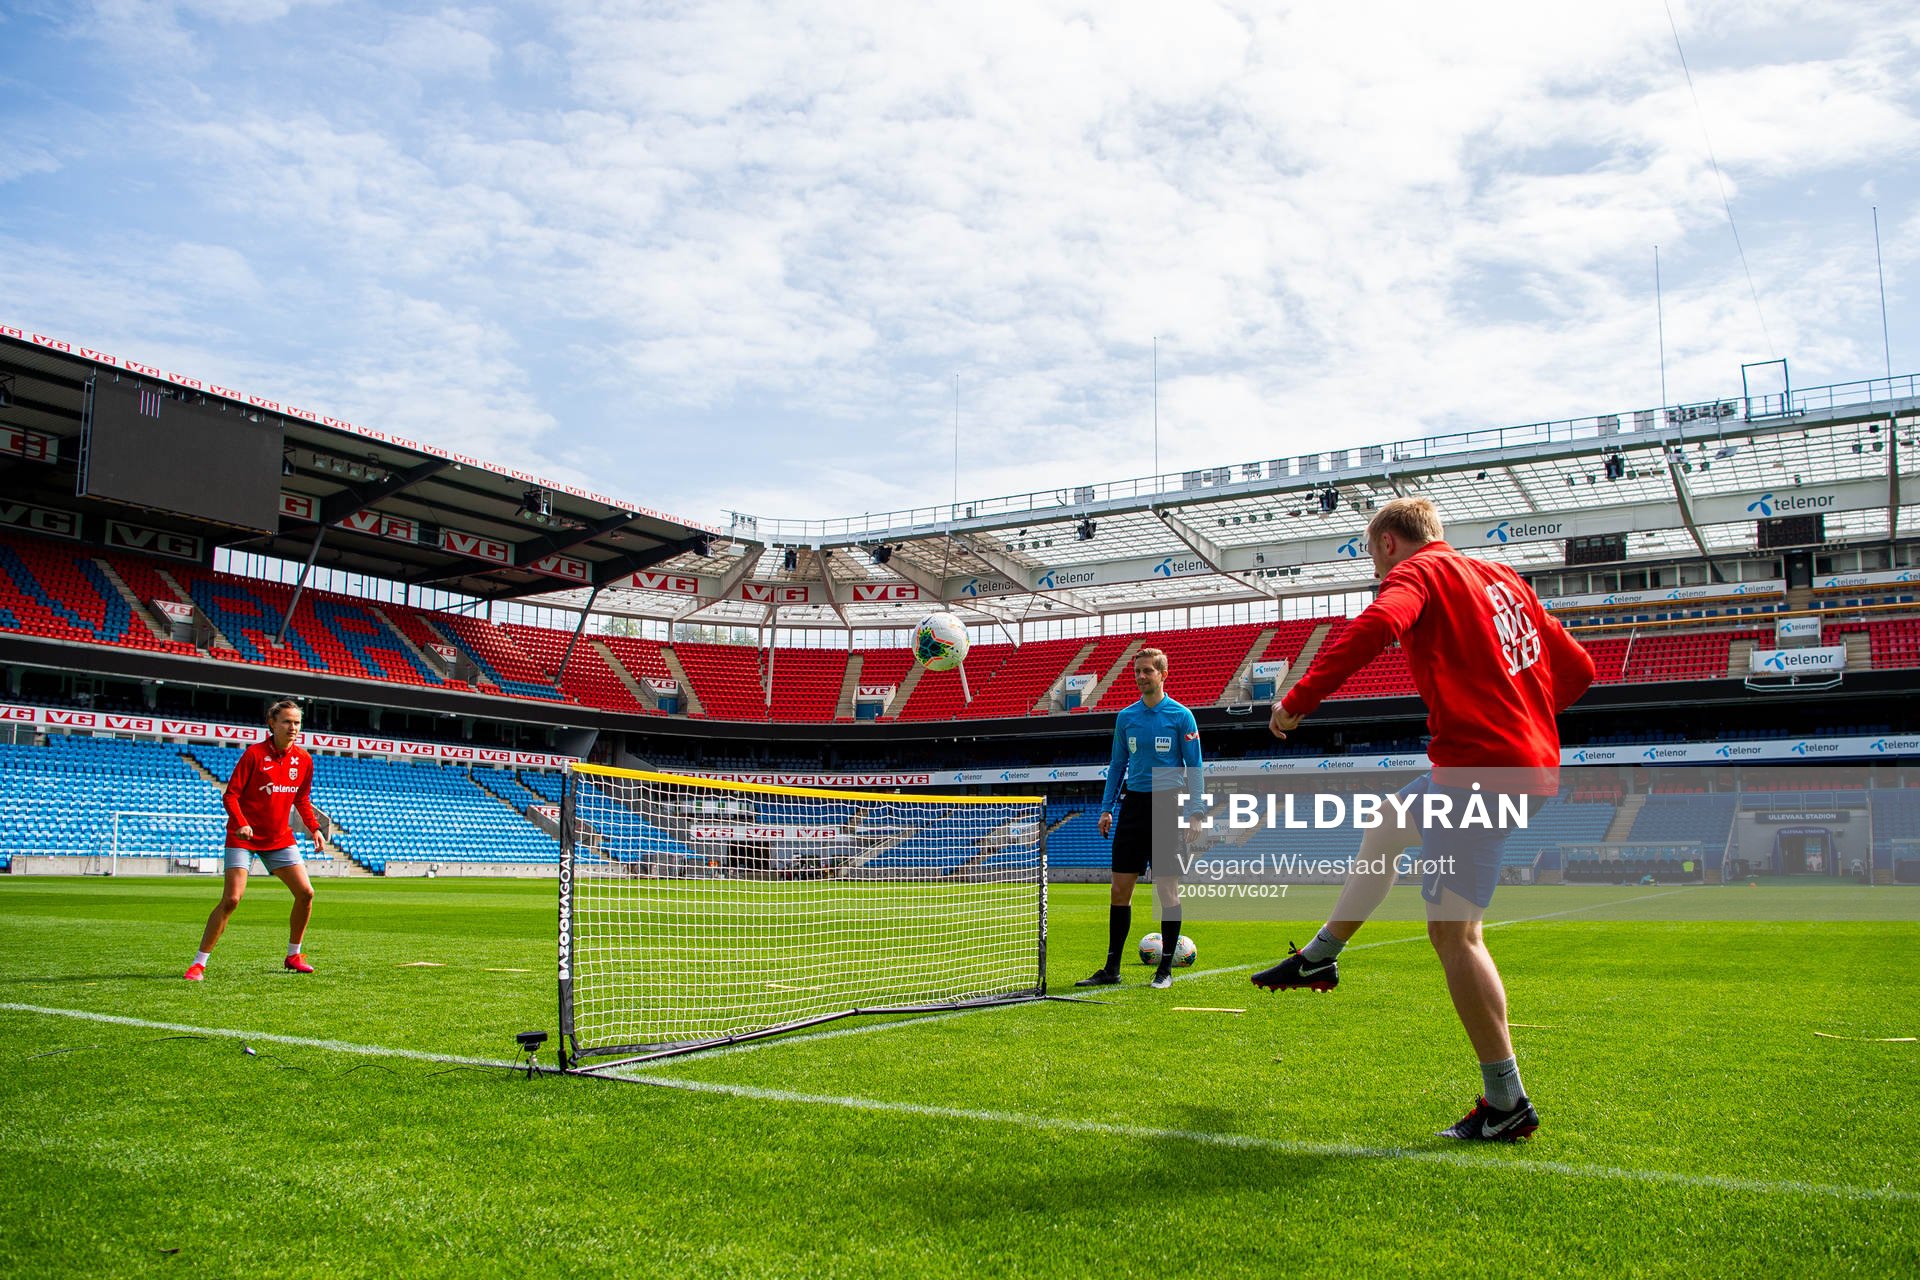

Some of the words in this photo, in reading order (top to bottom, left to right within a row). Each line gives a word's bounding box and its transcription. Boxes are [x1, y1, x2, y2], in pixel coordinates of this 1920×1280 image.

[33, 334, 70, 352] VG
[80, 348, 116, 365] VG
[126, 360, 159, 377] VG
[169, 373, 201, 389] VG
[210, 384, 241, 400] VG
[250, 395, 279, 412] VG
[287, 406, 315, 421] VG
[324, 416, 350, 430] VG
[358, 426, 384, 440] VG
[392, 435, 416, 449] VG
[423, 444, 447, 457] VG
[454, 452, 477, 466] VG
[483, 461, 506, 474] VG
[512, 470, 533, 482] VG
[539, 478, 560, 490] VG
[566, 485, 586, 497] VG
[591, 493, 610, 504] VG
[1774, 493, 1835, 511] telenor
[350, 509, 412, 541] VG
[1510, 522, 1562, 538] telenor
[113, 522, 194, 557] VG
[450, 531, 507, 562] VG
[539, 555, 587, 582] VG
[634, 573, 697, 594] VG
[1056, 571, 1095, 585] telenor
[743, 584, 808, 602] VG
[853, 584, 918, 601] VG
[1678, 590, 1707, 598] telenor
[1744, 584, 1775, 593] telenor
[1552, 600, 1579, 608] telenor
[1614, 595, 1642, 603] telenor
[1791, 622, 1818, 631] telenor
[1785, 652, 1834, 665] telenor
[646, 679, 677, 689] VG
[859, 686, 890, 696] VG
[47, 711, 94, 726] VG
[106, 716, 151, 731] VG
[163, 721, 205, 736] VG
[216, 727, 256, 740] VG
[313, 735, 350, 748] VG
[358, 739, 393, 752] VG
[1805, 743, 1839, 753] telenor
[1883, 740, 1919, 750] telenor
[401, 743, 434, 756] VG
[441, 747, 473, 759] VG
[480, 750, 510, 761] VG
[1585, 752, 1615, 760] telenor
[1656, 749, 1687, 758] telenor
[1729, 746, 1762, 755] telenor
[516, 753, 545, 765] VG
[1328, 760, 1354, 769] telenor
[1389, 757, 1416, 767] telenor
[1057, 769, 1079, 777] telenor
[1213, 764, 1237, 772] telenor
[739, 775, 774, 784] VG
[778, 775, 815, 785] VG
[818, 776, 854, 785] VG
[858, 776, 893, 785] VG
[896, 775, 929, 784] VG
[962, 773, 982, 781] telenor
[1009, 771, 1030, 779] telenor
[272, 785, 299, 793] telenor
[559, 849, 570, 980] BAZOOKAGOAL
